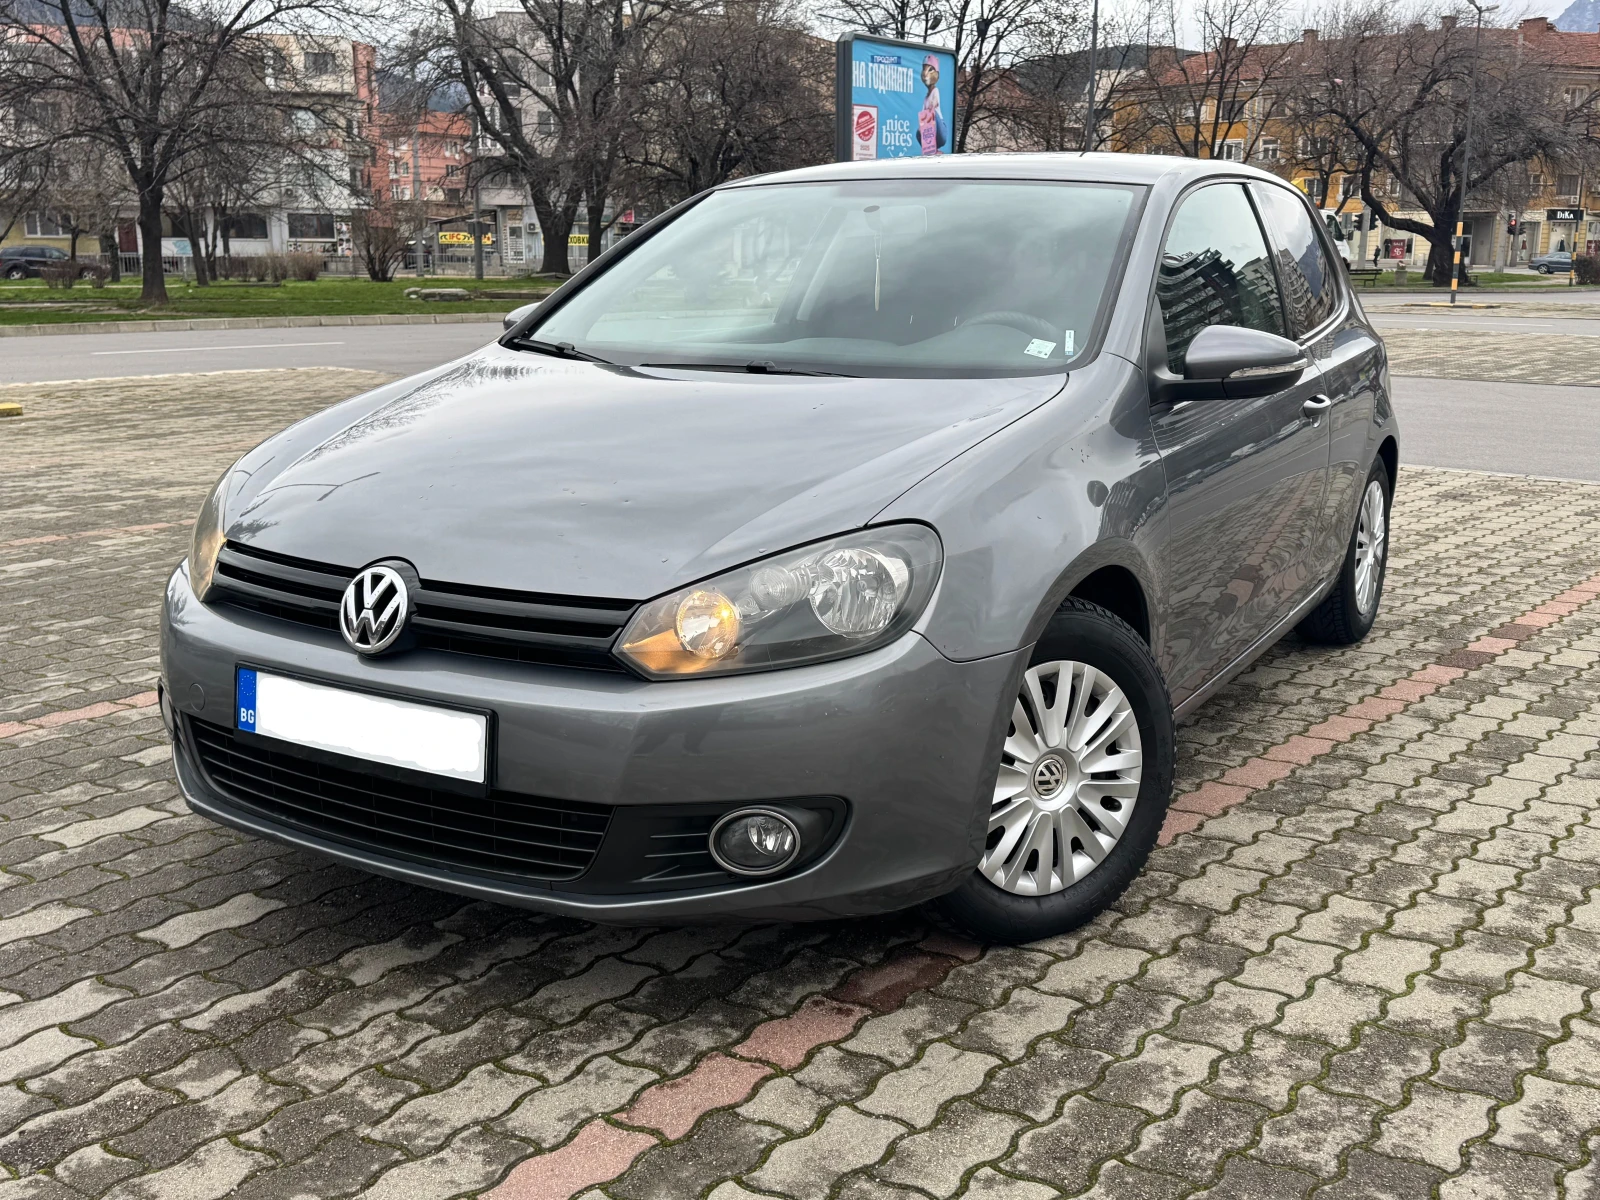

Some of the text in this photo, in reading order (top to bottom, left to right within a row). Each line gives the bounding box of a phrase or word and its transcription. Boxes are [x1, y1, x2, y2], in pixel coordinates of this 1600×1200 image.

[852, 60, 914, 94] НА ГОДИНАТА
[886, 114, 910, 132] nice
[882, 125, 913, 147] bites
[340, 565, 407, 652] VW
[240, 707, 255, 724] BG
